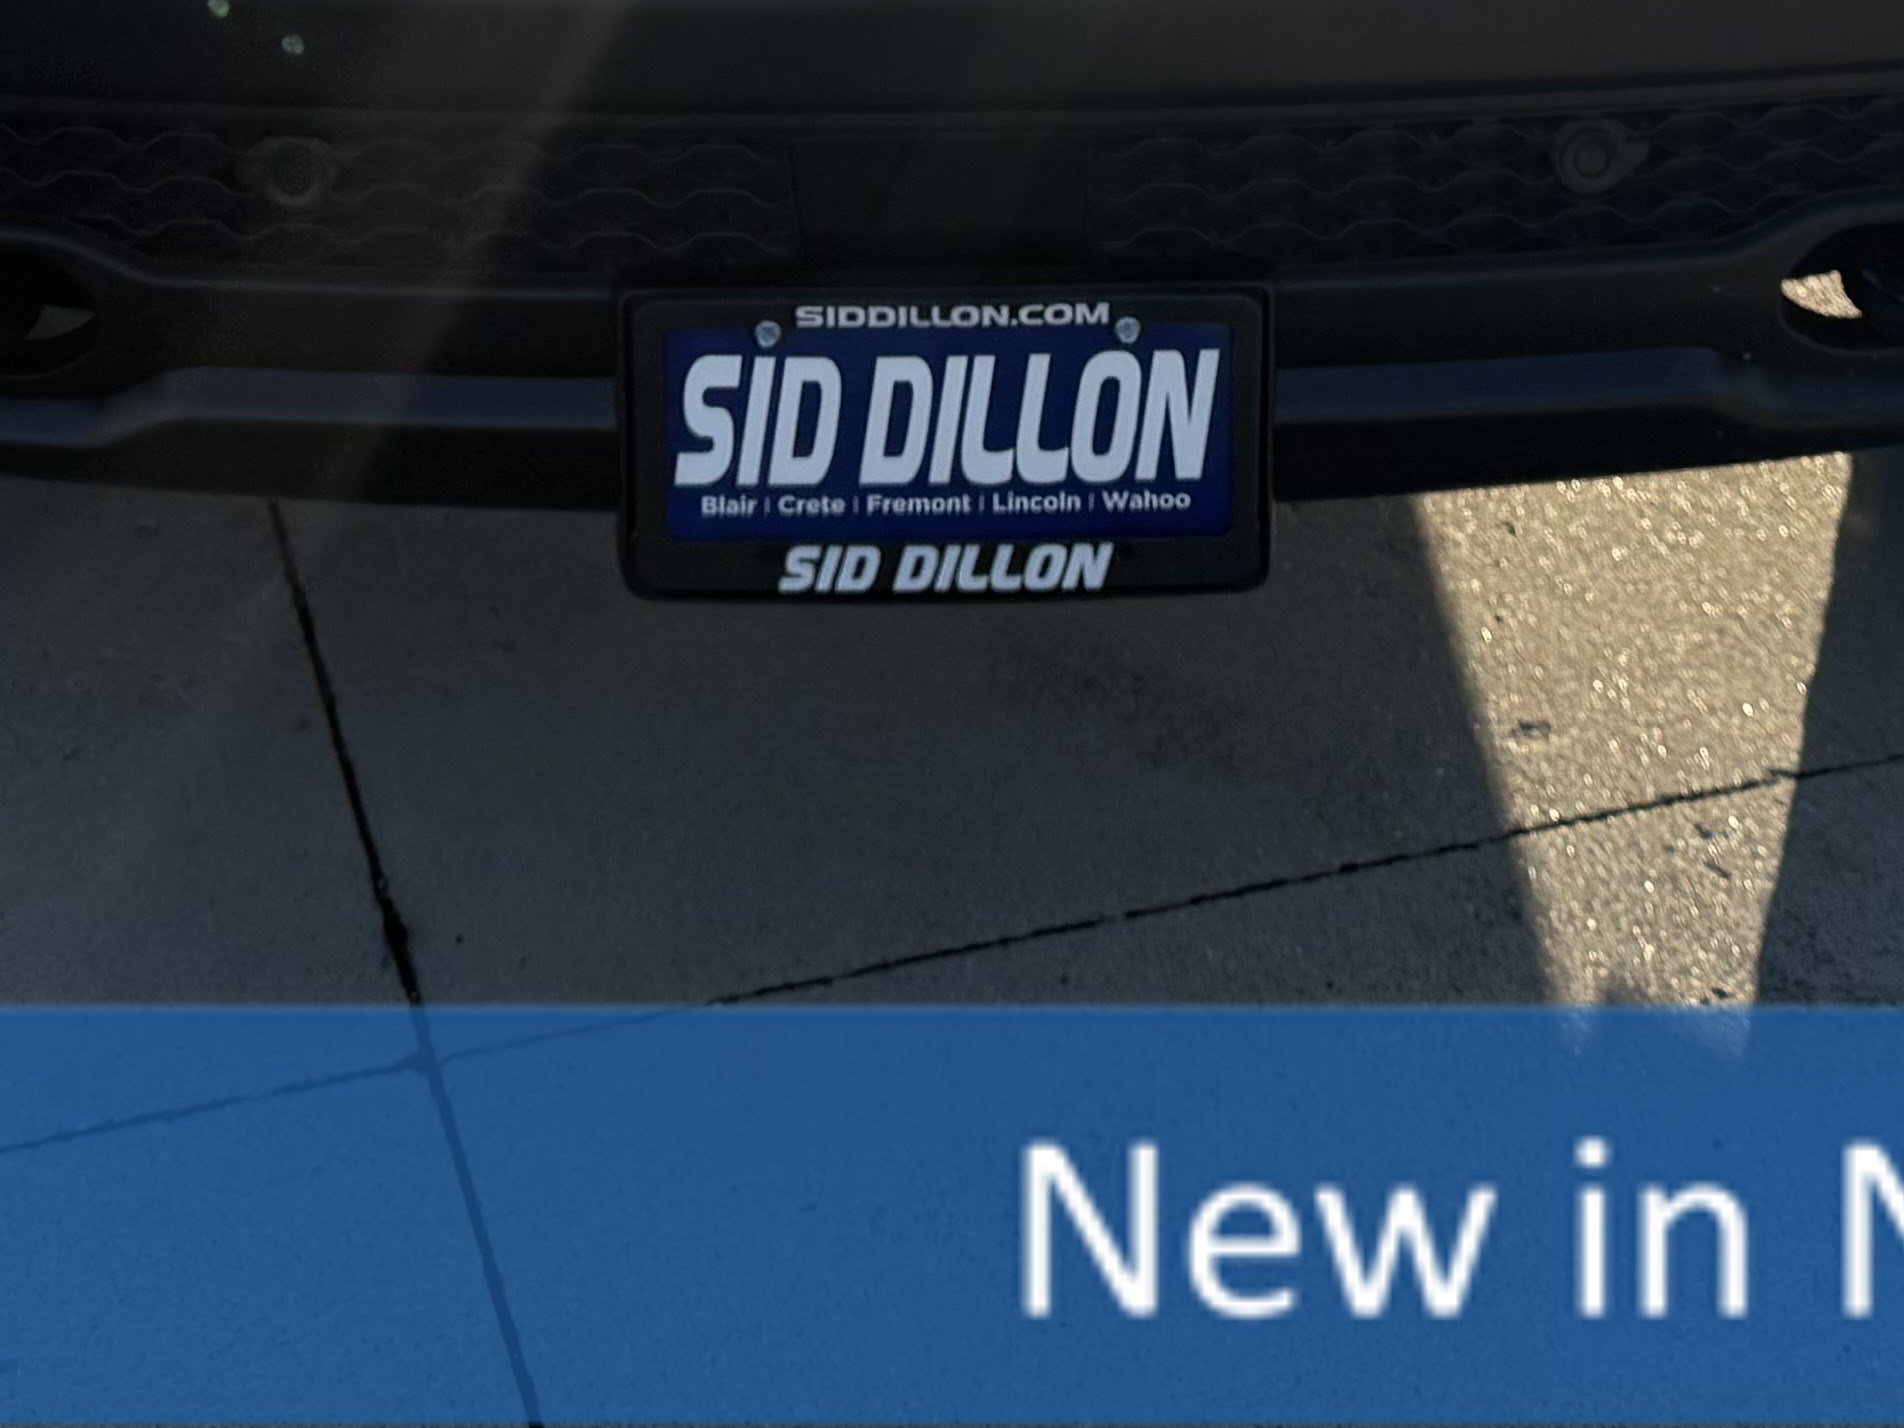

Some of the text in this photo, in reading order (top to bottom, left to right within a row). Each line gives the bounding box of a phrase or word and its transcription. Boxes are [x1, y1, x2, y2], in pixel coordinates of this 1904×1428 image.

[794, 301, 1111, 329] SIDDILLON.COM
[673, 347, 1220, 486] SID DILLON
[700, 489, 1192, 516] Blair Crete Fremont Lincoln Wahoo
[778, 542, 1115, 593] SID DILLON
